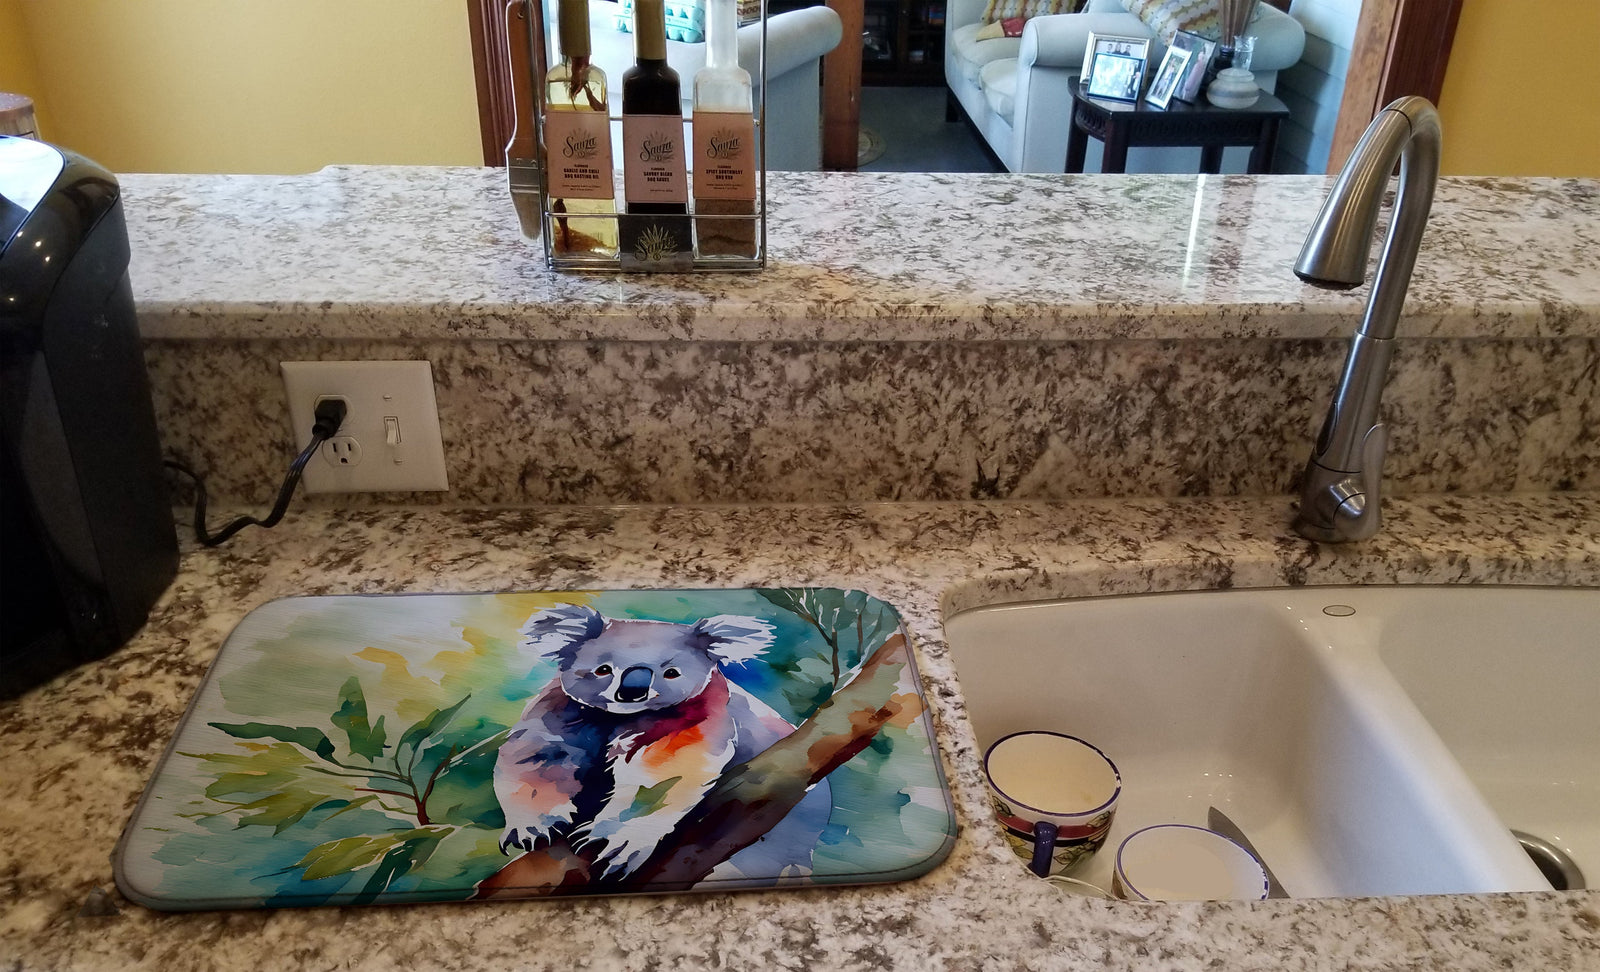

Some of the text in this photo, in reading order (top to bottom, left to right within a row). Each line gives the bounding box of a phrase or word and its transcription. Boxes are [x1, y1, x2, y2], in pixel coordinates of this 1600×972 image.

[563, 136, 597, 158] Sauza
[640, 140, 674, 161] Sauza
[706, 137, 741, 159] Sauza
